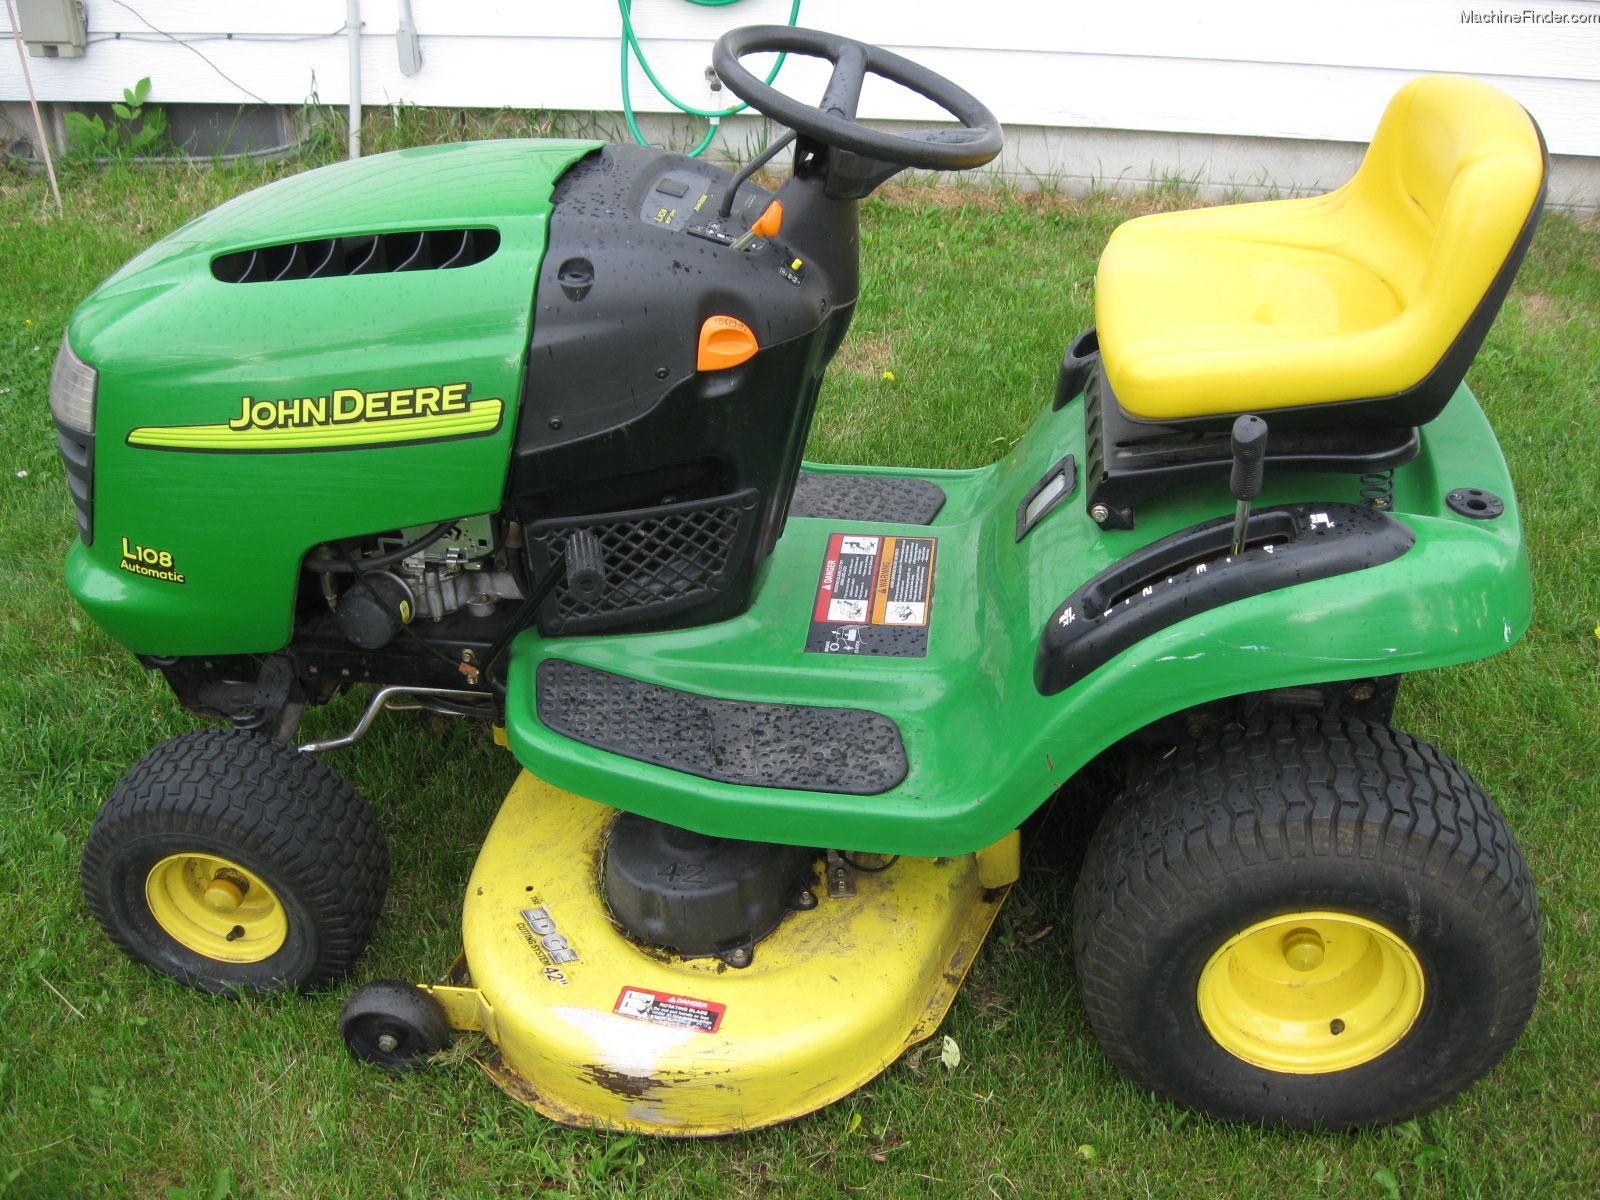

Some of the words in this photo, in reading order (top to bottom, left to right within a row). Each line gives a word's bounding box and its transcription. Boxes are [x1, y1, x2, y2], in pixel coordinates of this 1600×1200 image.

[229, 396, 328, 429] JOHN
[331, 382, 468, 422] DEERE
[122, 536, 173, 568] L108
[120, 559, 185, 583] Automatic
[824, 560, 836, 584] DANGER
[880, 561, 891, 588] WARNING
[1142, 585, 1153, 597] 2
[1195, 563, 1207, 575] 3
[1263, 544, 1274, 554] 4
[656, 862, 706, 884] 42
[516, 922, 537, 946] CUTTING
[531, 943, 552, 967] SYSTEM
[520, 906, 580, 965] EDGE
[676, 998, 708, 1009] DANGER
